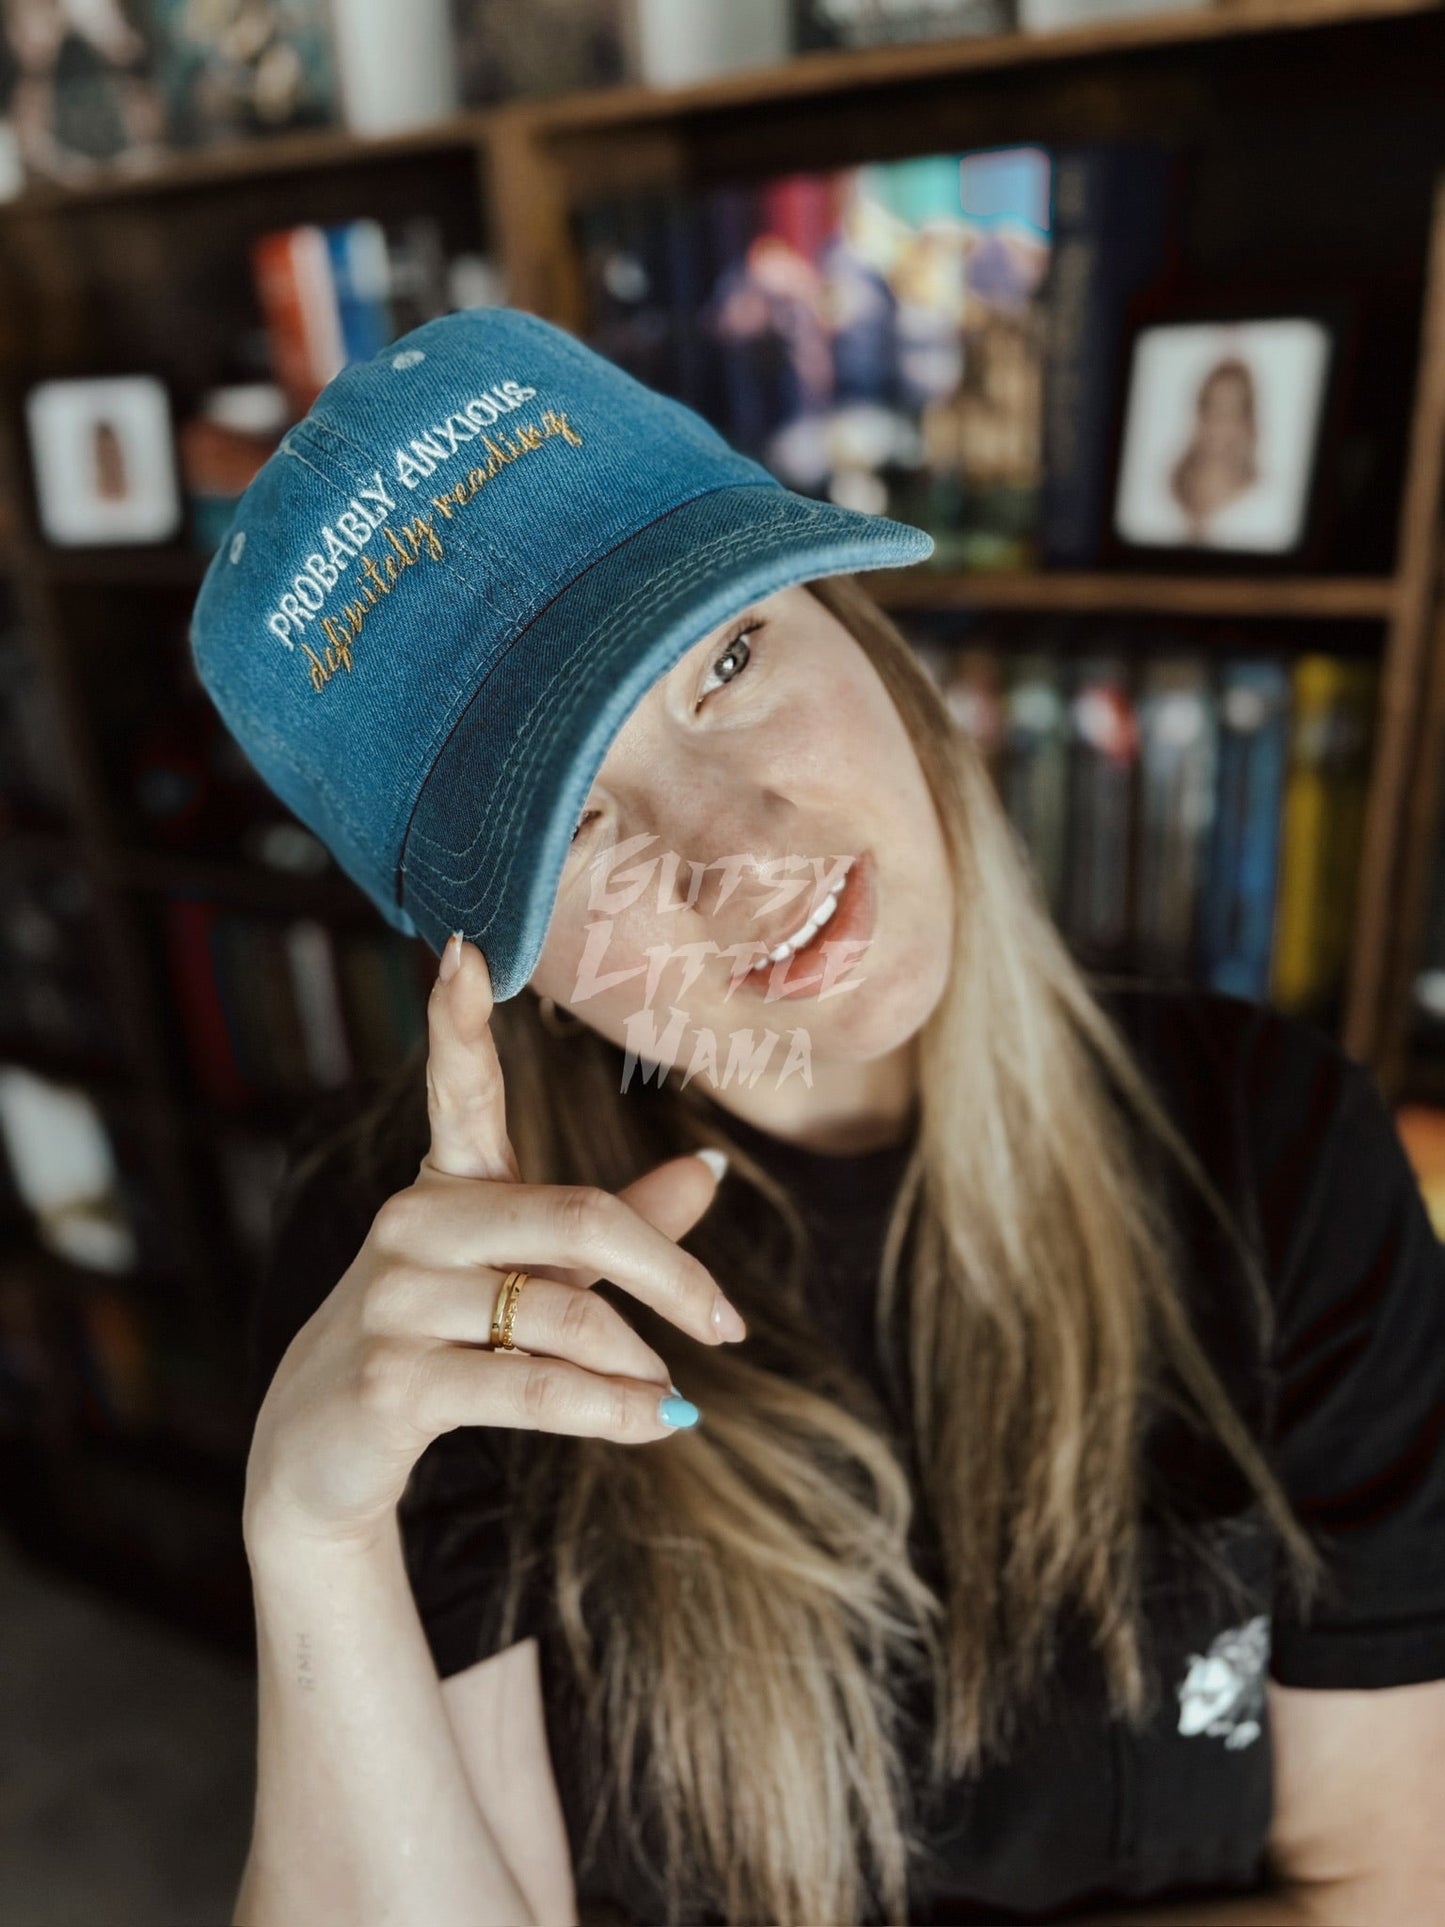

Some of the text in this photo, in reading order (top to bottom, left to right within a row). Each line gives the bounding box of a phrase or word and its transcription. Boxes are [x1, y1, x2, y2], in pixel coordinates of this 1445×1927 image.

[268, 379, 538, 651] PROBABLY ANXIOUS
[301, 409, 584, 694] definitely reading
